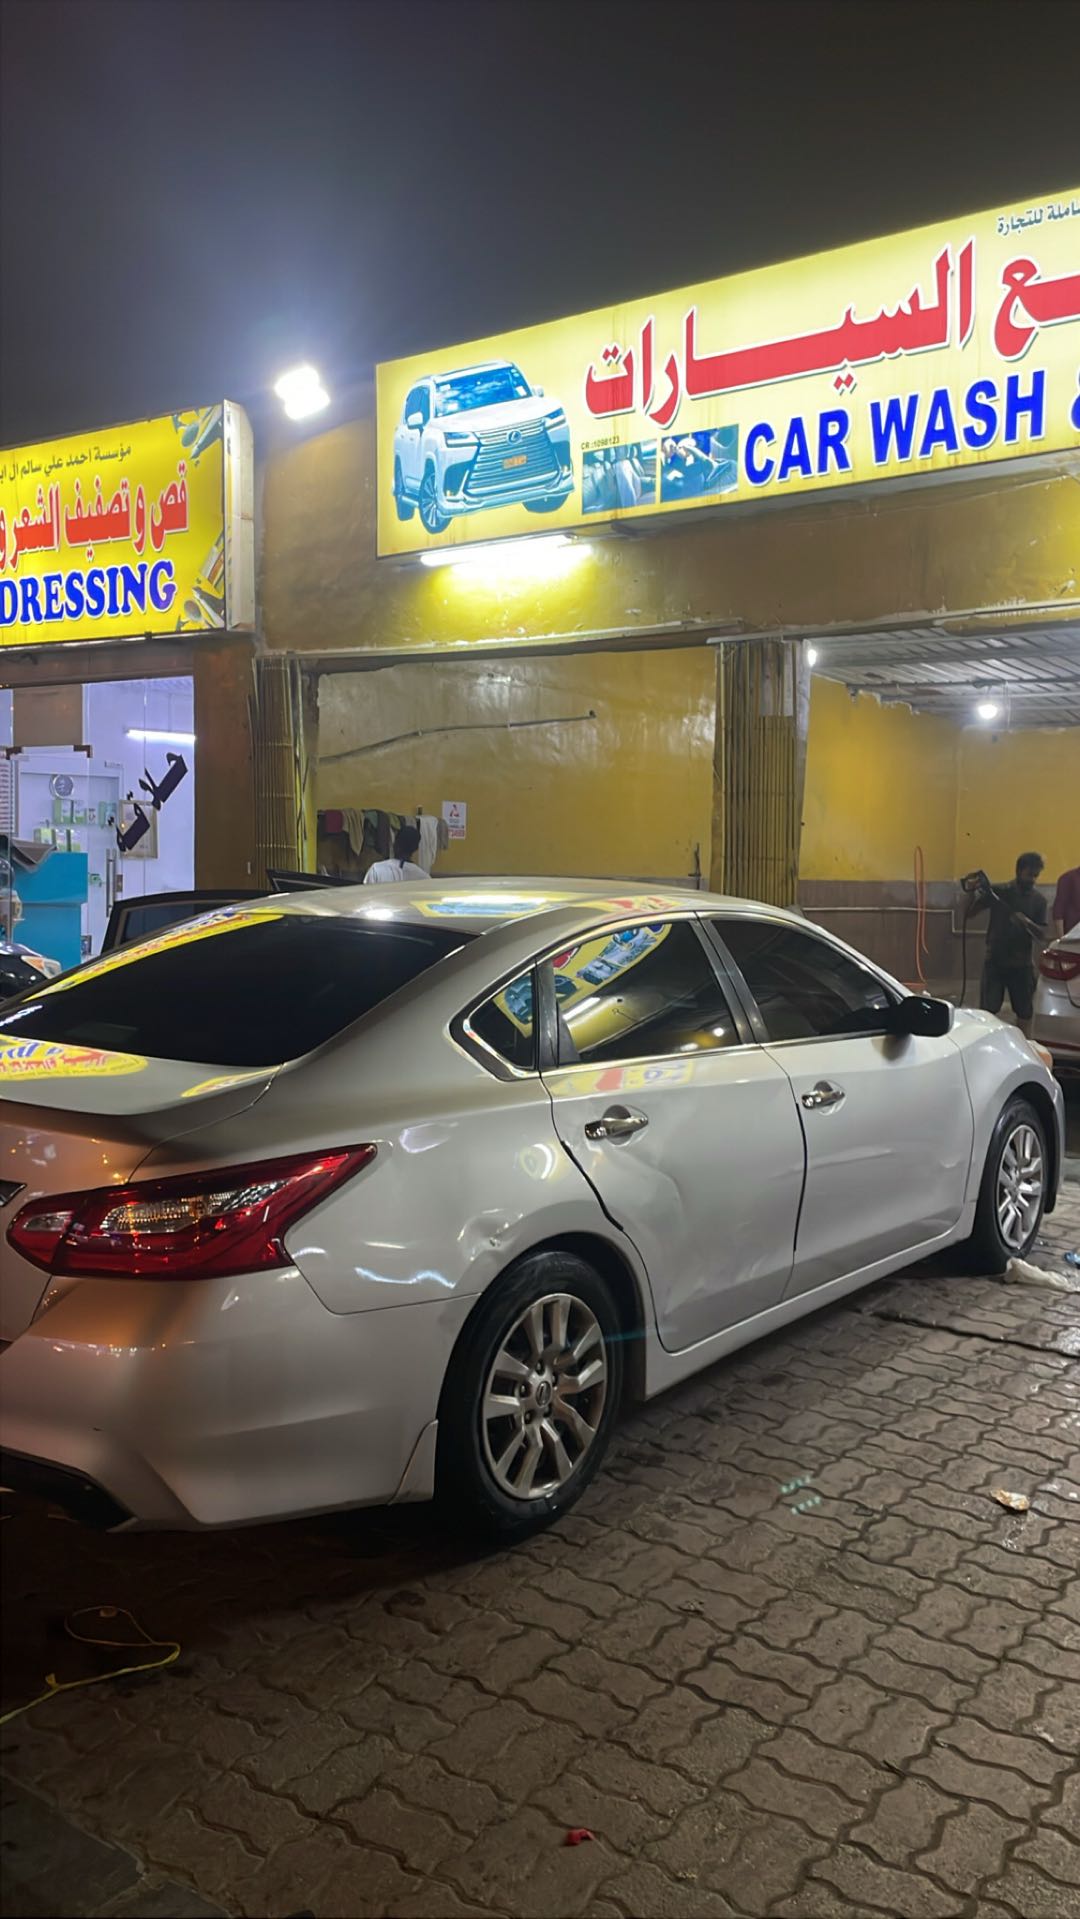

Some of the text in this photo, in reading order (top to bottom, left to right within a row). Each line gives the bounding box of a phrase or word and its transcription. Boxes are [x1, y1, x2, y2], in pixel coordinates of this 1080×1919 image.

[997, 208, 1044, 236] للتجارة
[584, 236, 975, 429] السيارات
[94, 443, 131, 462] مؤسسة
[744, 407, 850, 486] CAR
[870, 369, 1046, 464] WASH
[44, 455, 63, 476] علي
[9, 484, 60, 571] الشعر
[64, 478, 131, 560] تصفيف
[134, 486, 146, 553] و
[150, 461, 188, 552] قص
[0, 560, 176, 626] DRESSING
